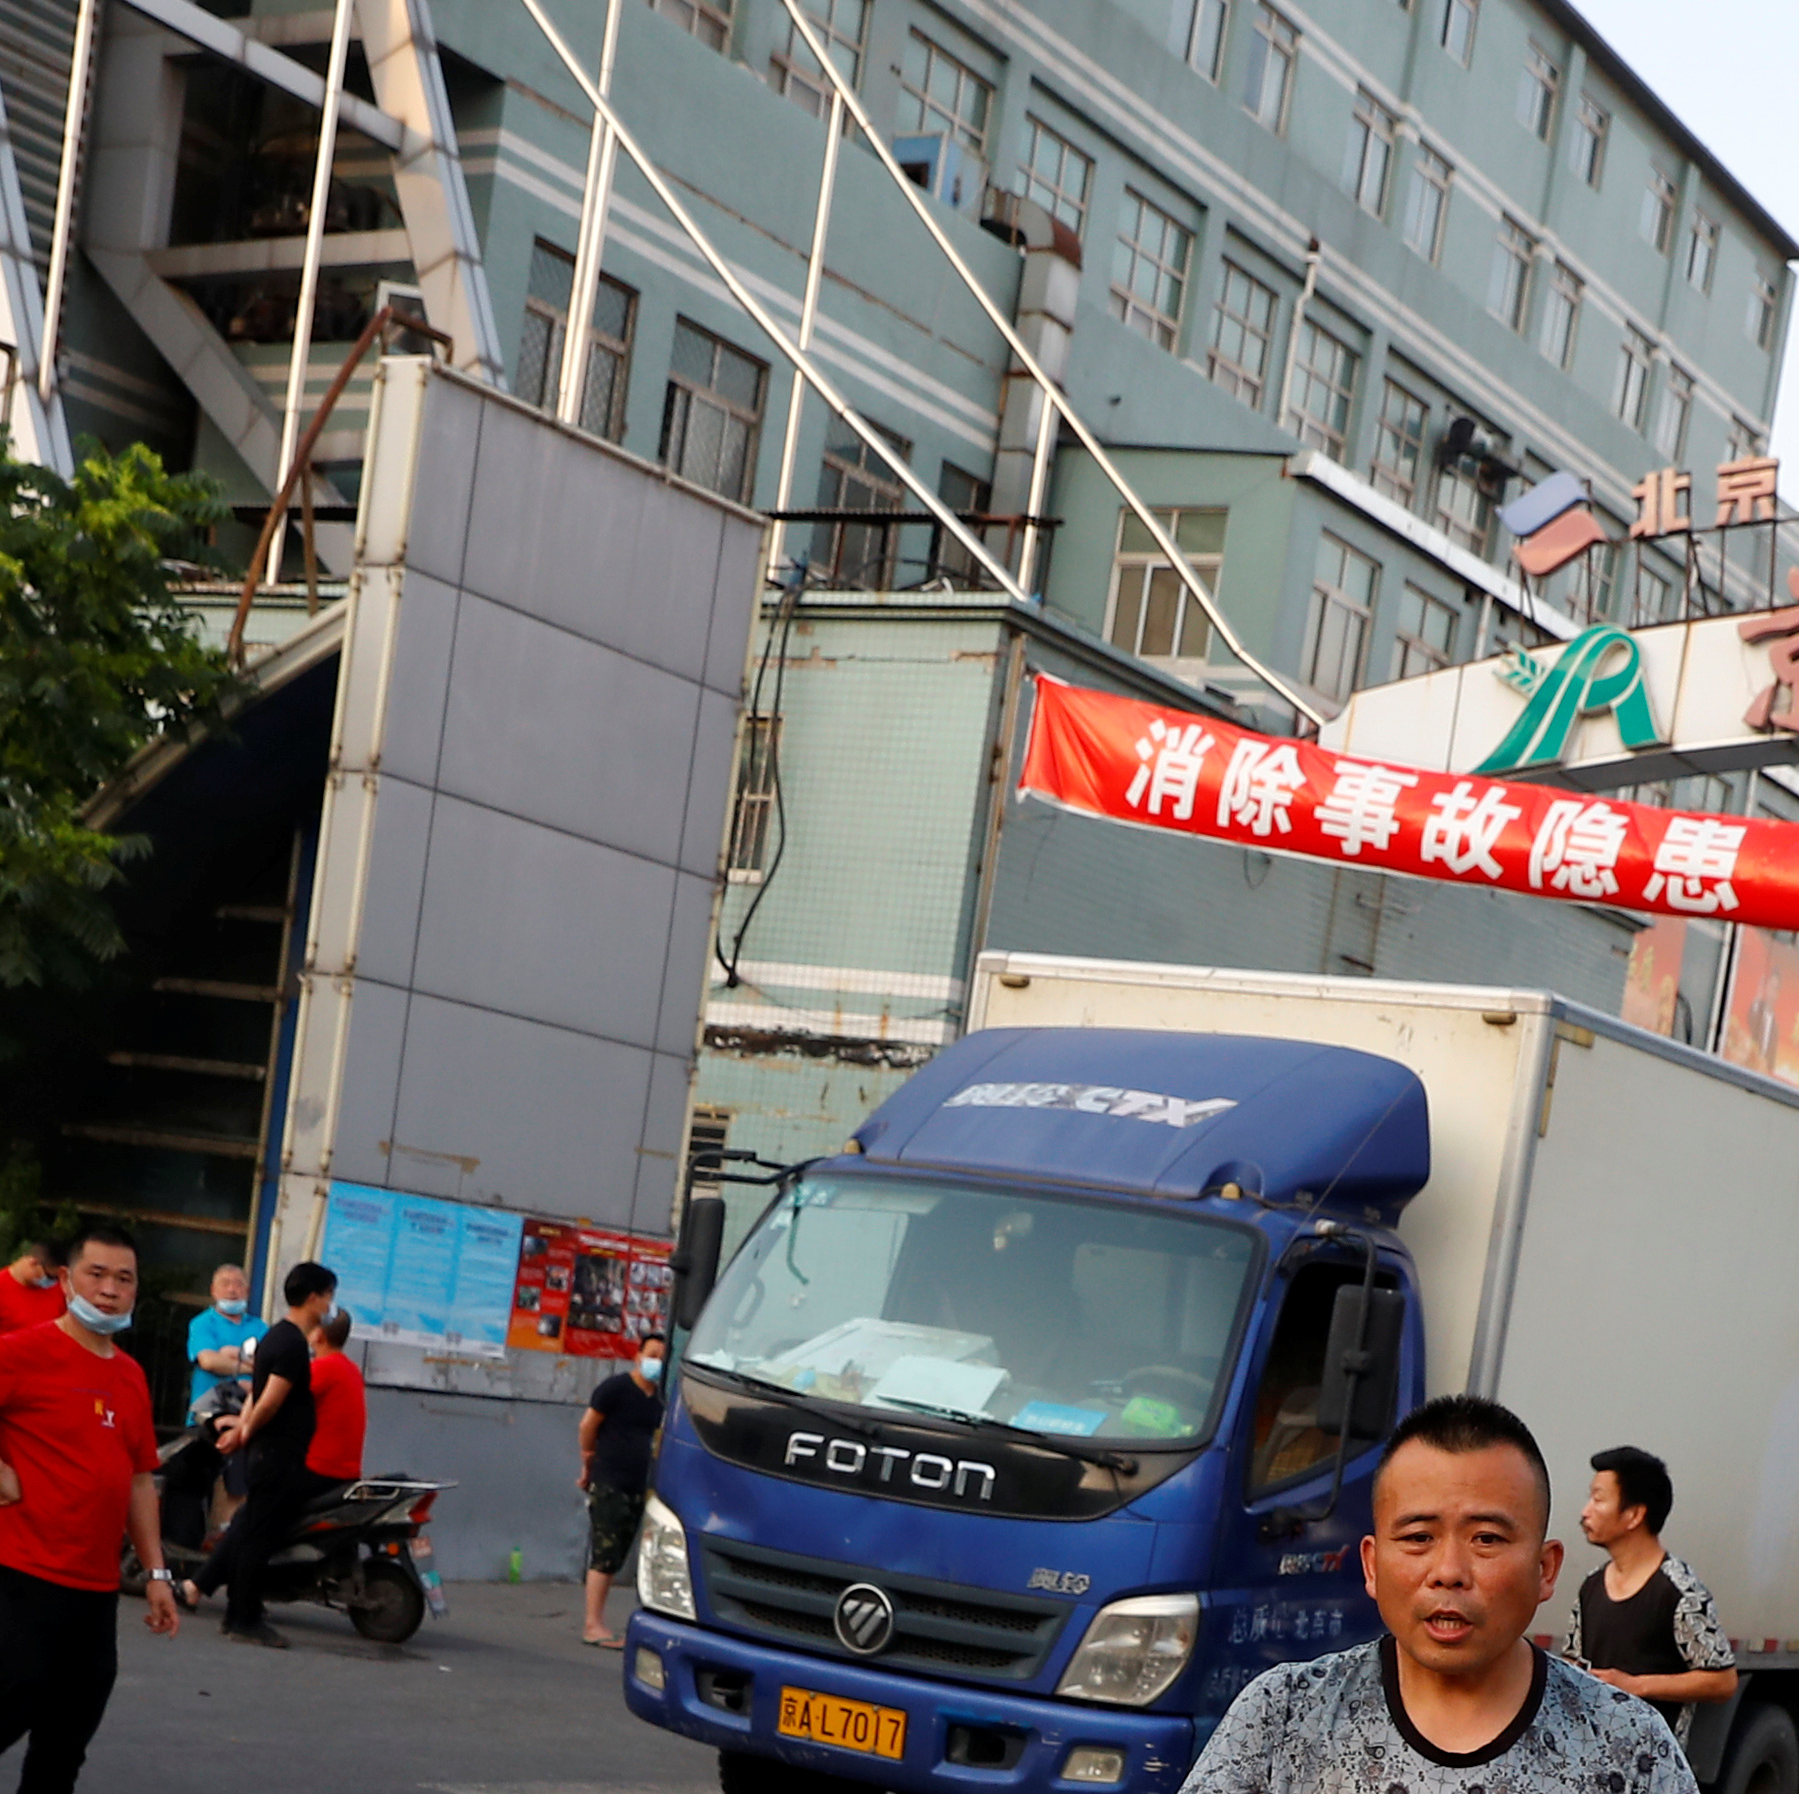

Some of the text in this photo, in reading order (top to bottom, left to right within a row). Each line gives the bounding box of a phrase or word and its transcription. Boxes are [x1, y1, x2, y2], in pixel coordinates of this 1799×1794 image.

[1125, 719, 1747, 915] 消除事故隐患
[784, 1431, 997, 1501] FOTON
